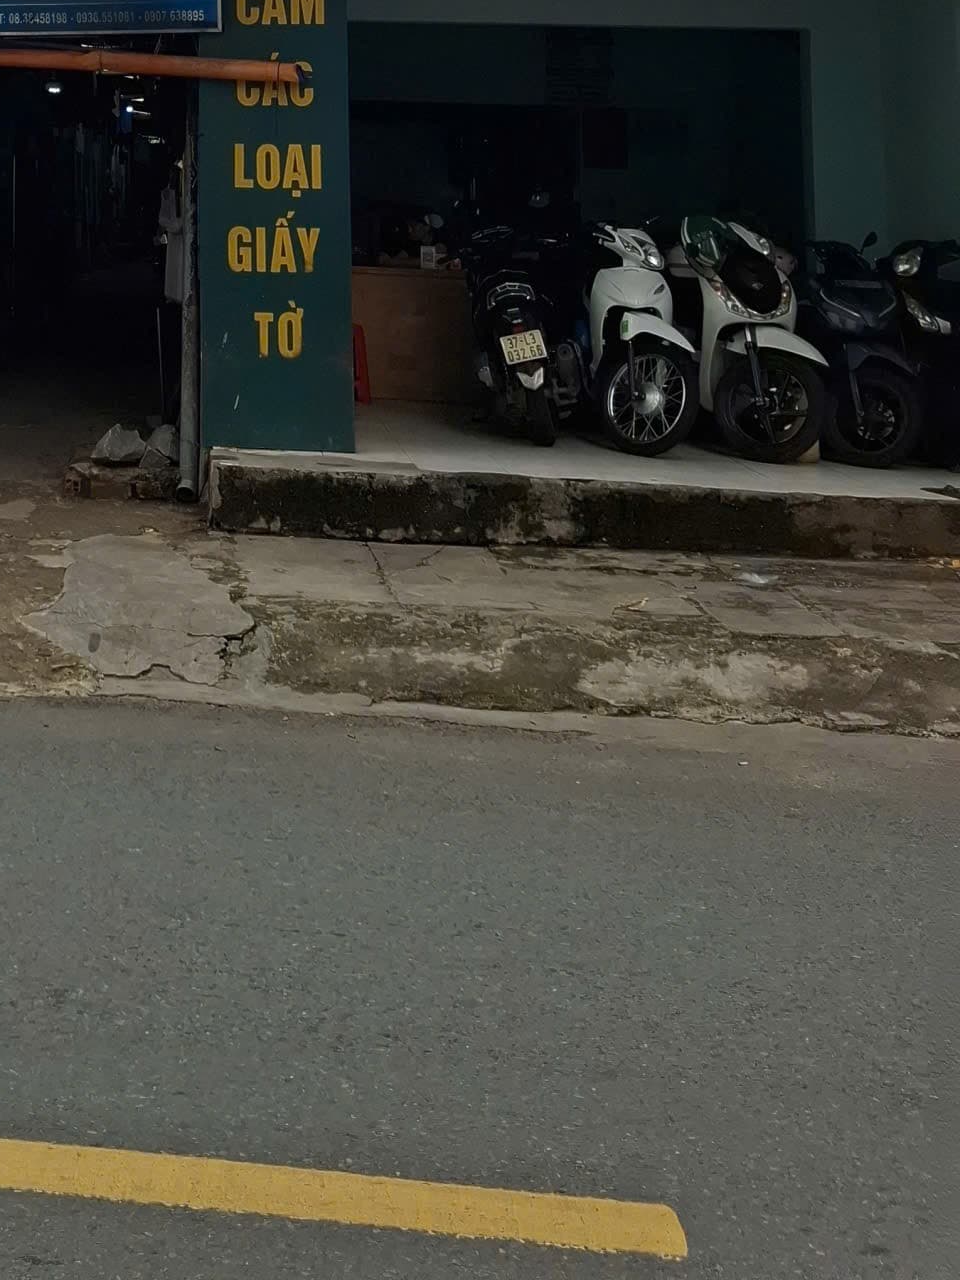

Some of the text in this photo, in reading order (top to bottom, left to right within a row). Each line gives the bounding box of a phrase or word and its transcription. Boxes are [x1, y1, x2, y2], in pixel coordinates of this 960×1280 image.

[234, 141, 323, 198] LOẠI
[227, 210, 321, 275] GIẤY
[254, 300, 304, 360] TỜ
